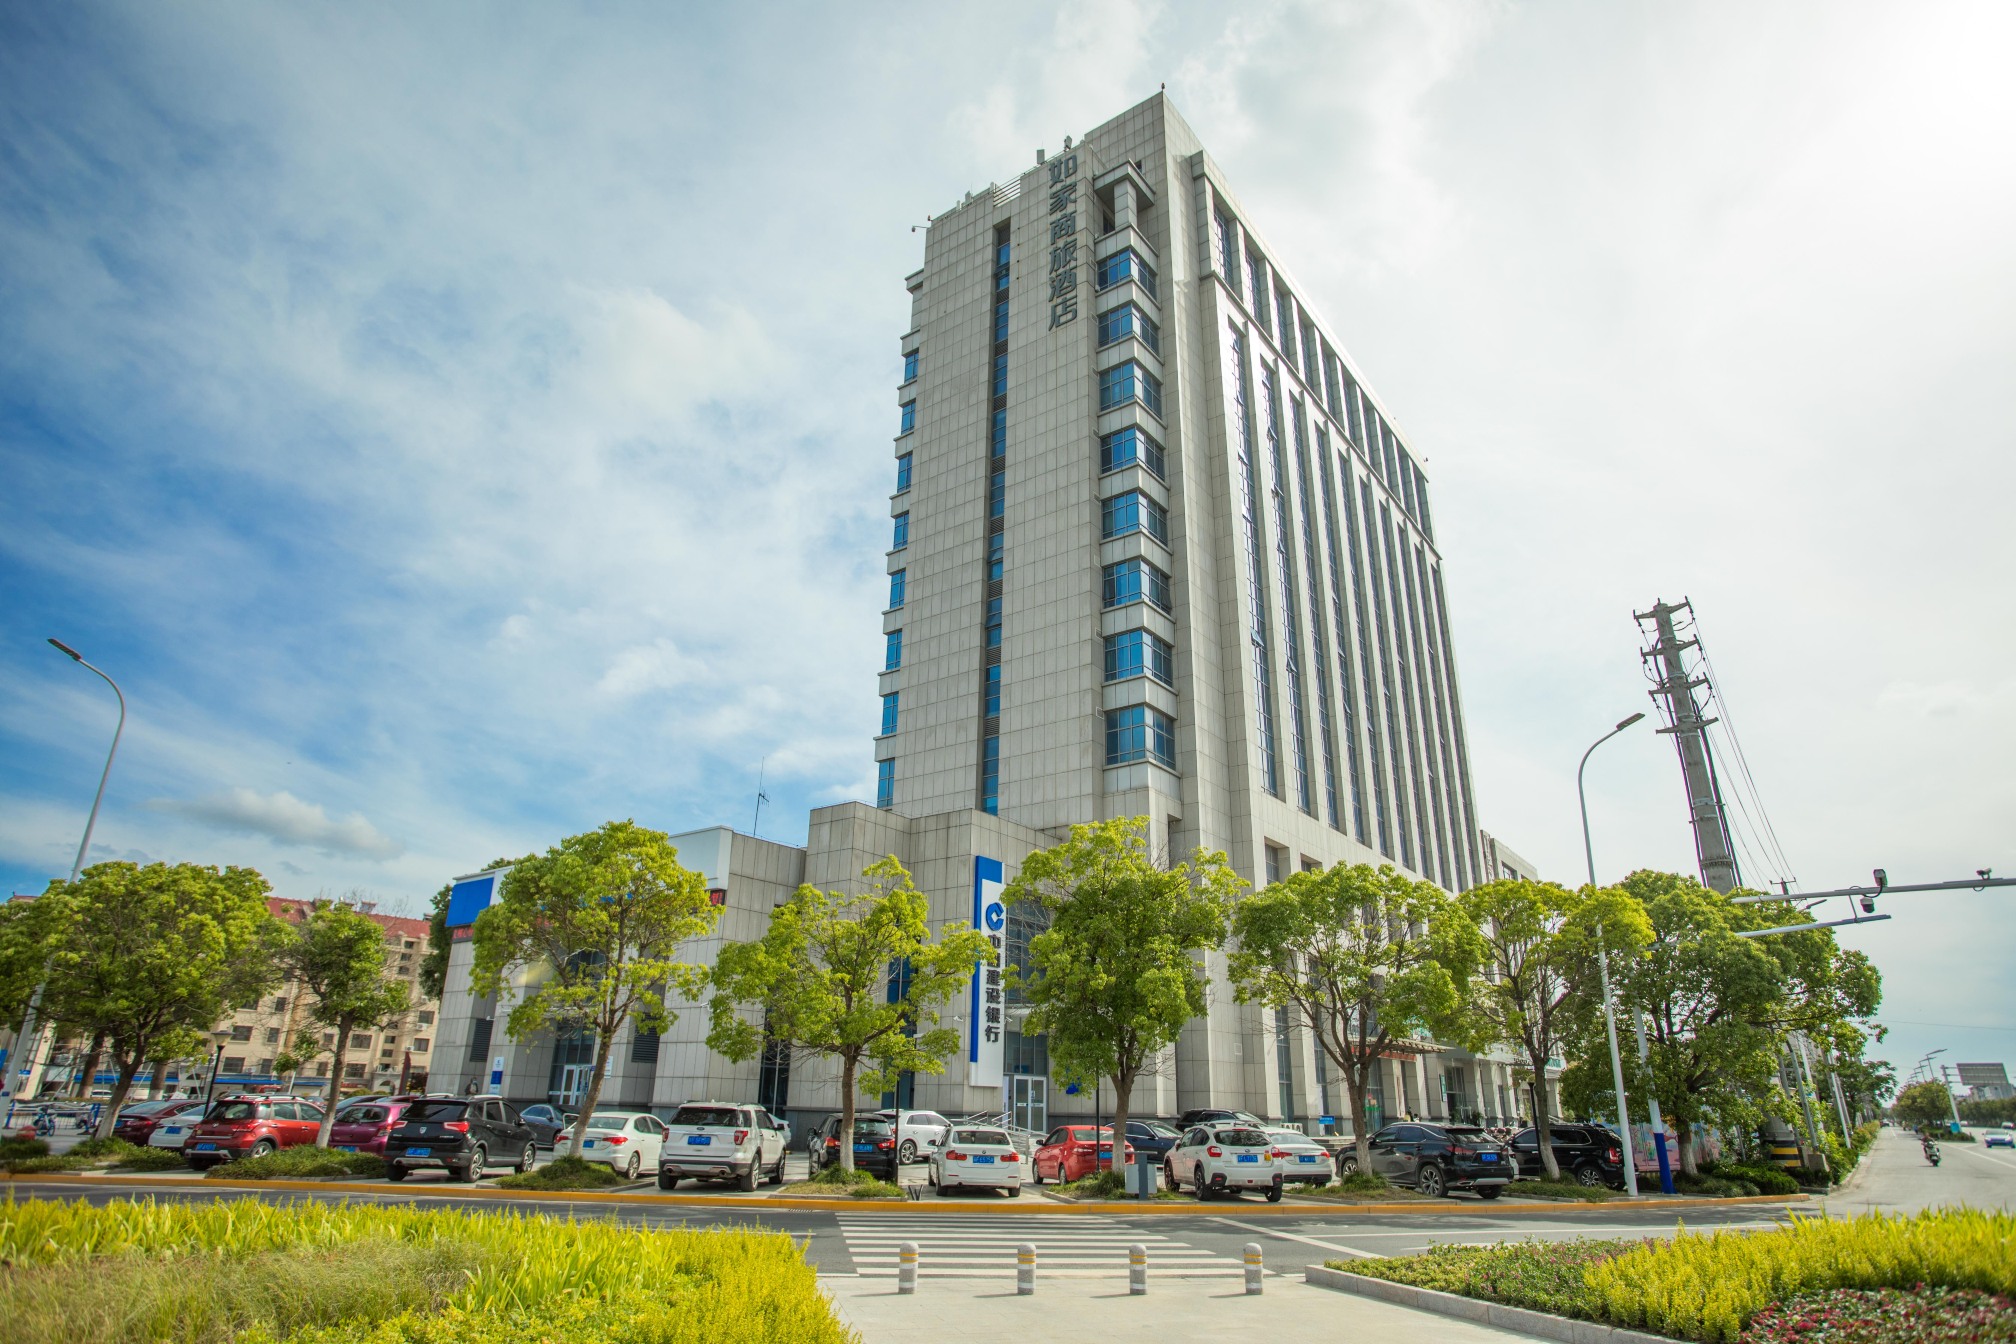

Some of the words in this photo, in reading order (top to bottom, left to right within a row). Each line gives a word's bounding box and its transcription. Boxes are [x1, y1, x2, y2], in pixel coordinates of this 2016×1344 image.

[1048, 154, 1078, 331] 如家商旅酒店
